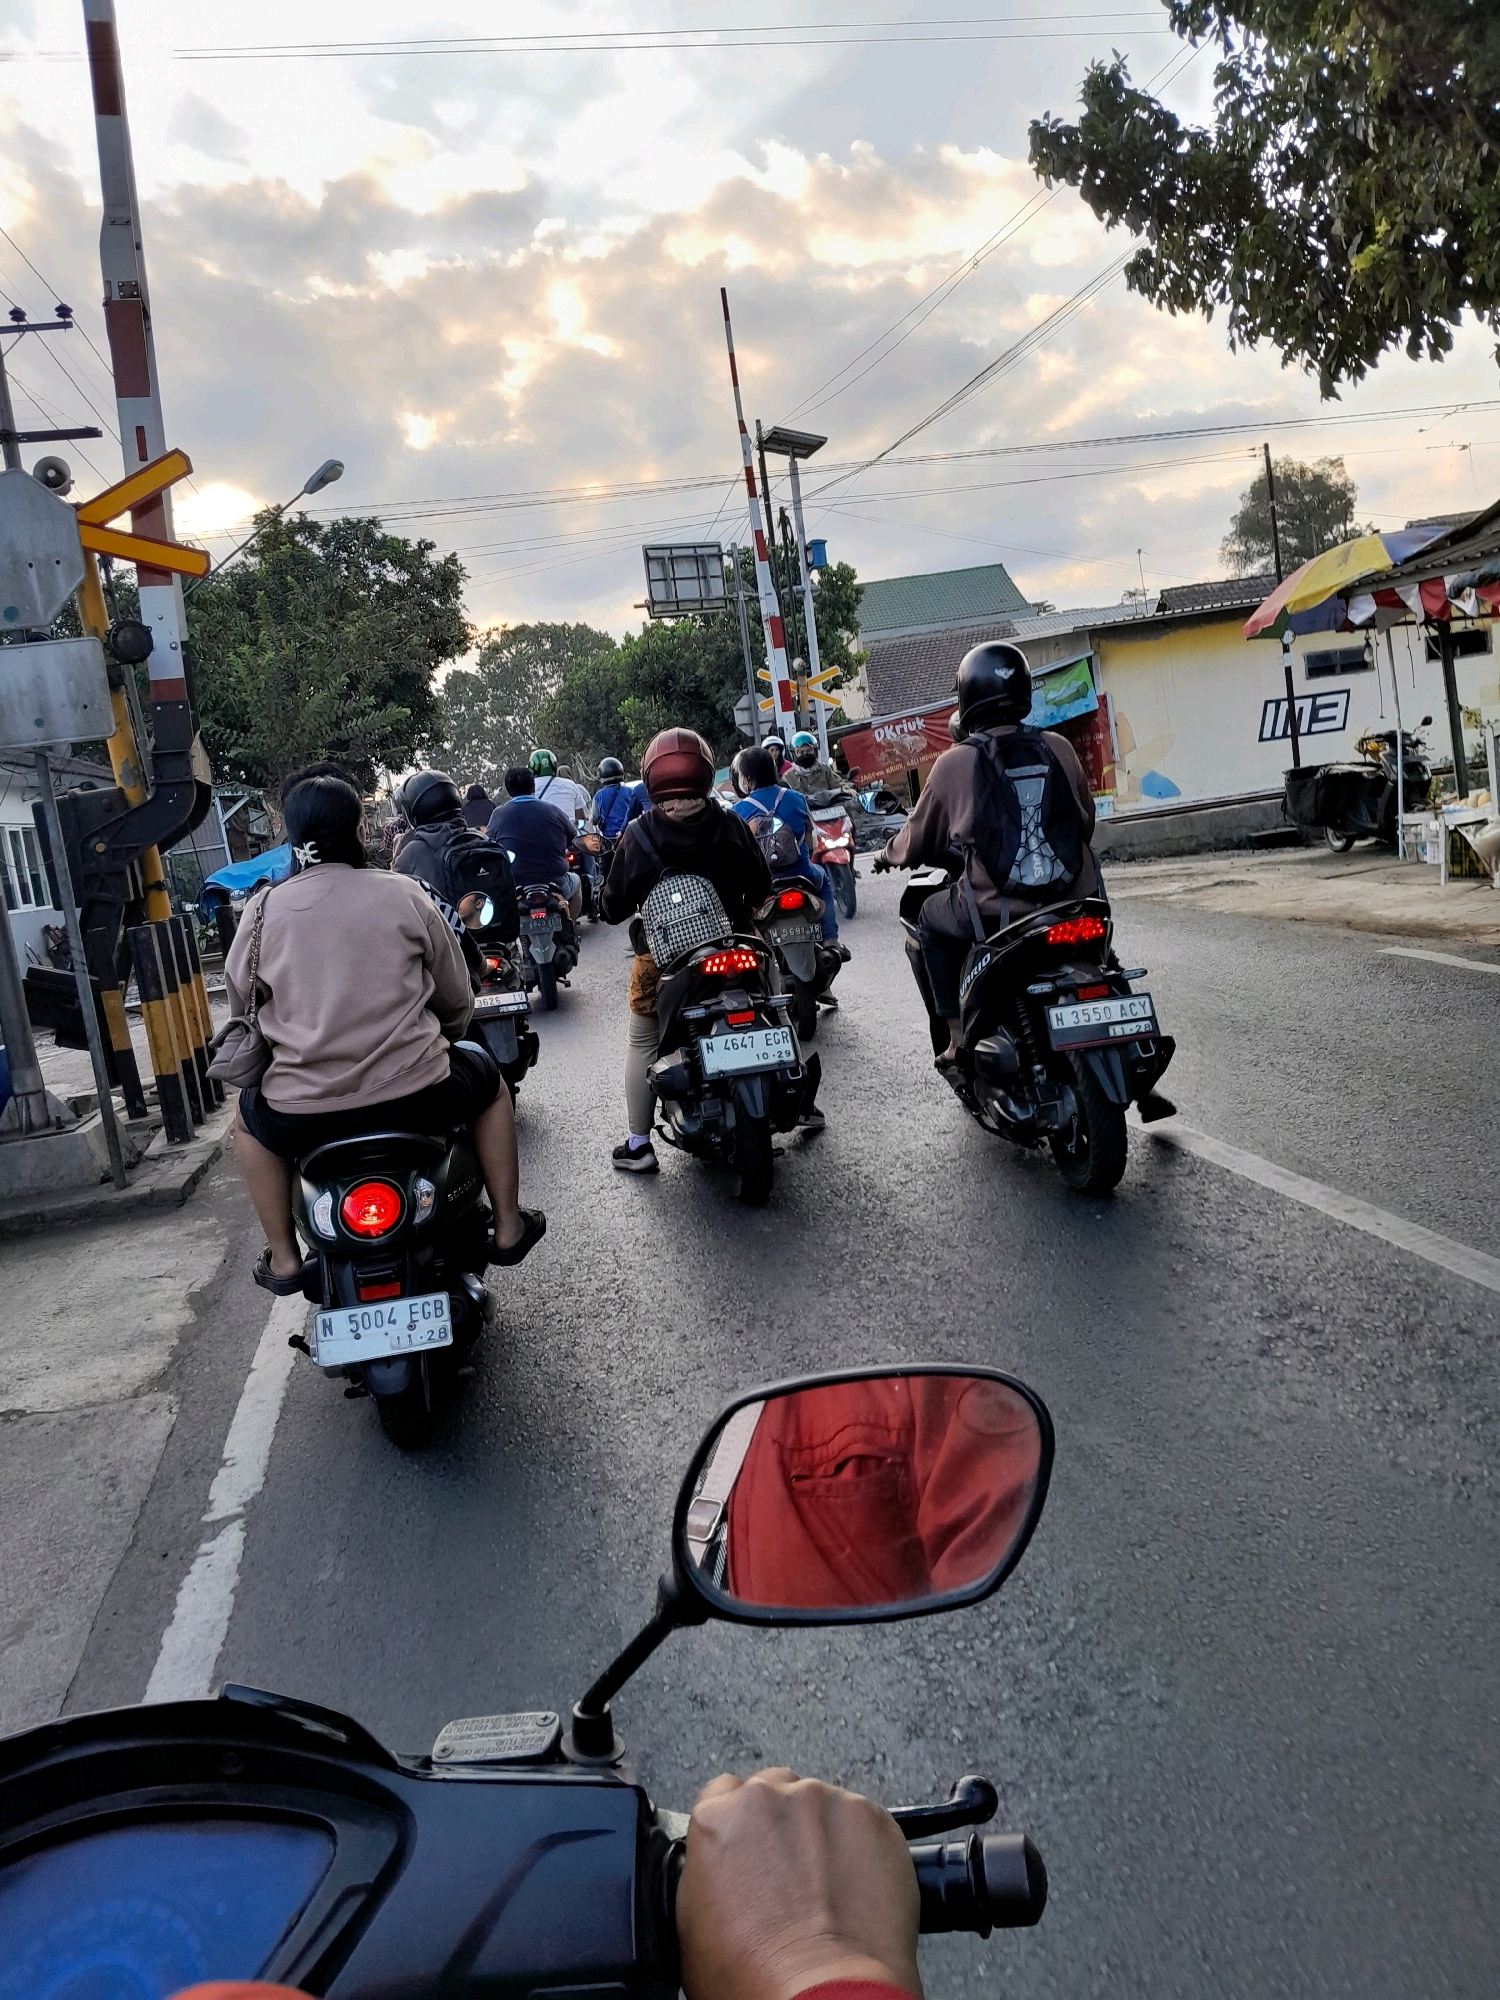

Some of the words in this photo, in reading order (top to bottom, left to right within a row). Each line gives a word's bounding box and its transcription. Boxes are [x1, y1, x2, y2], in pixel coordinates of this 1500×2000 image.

[874, 717, 926, 742] DKriuk
[1262, 692, 1348, 739] IM3
[960, 952, 991, 998] VARIO
[1055, 1012, 1065, 1027] N
[1071, 1005, 1112, 1025] 3550
[1120, 1000, 1148, 1018] ACY
[705, 1041, 715, 1054] N
[723, 1035, 755, 1051] 4647
[764, 1031, 789, 1046] EGR
[322, 1316, 333, 1338] N
[348, 1306, 398, 1334] 5004
[409, 1299, 445, 1323] EGB
